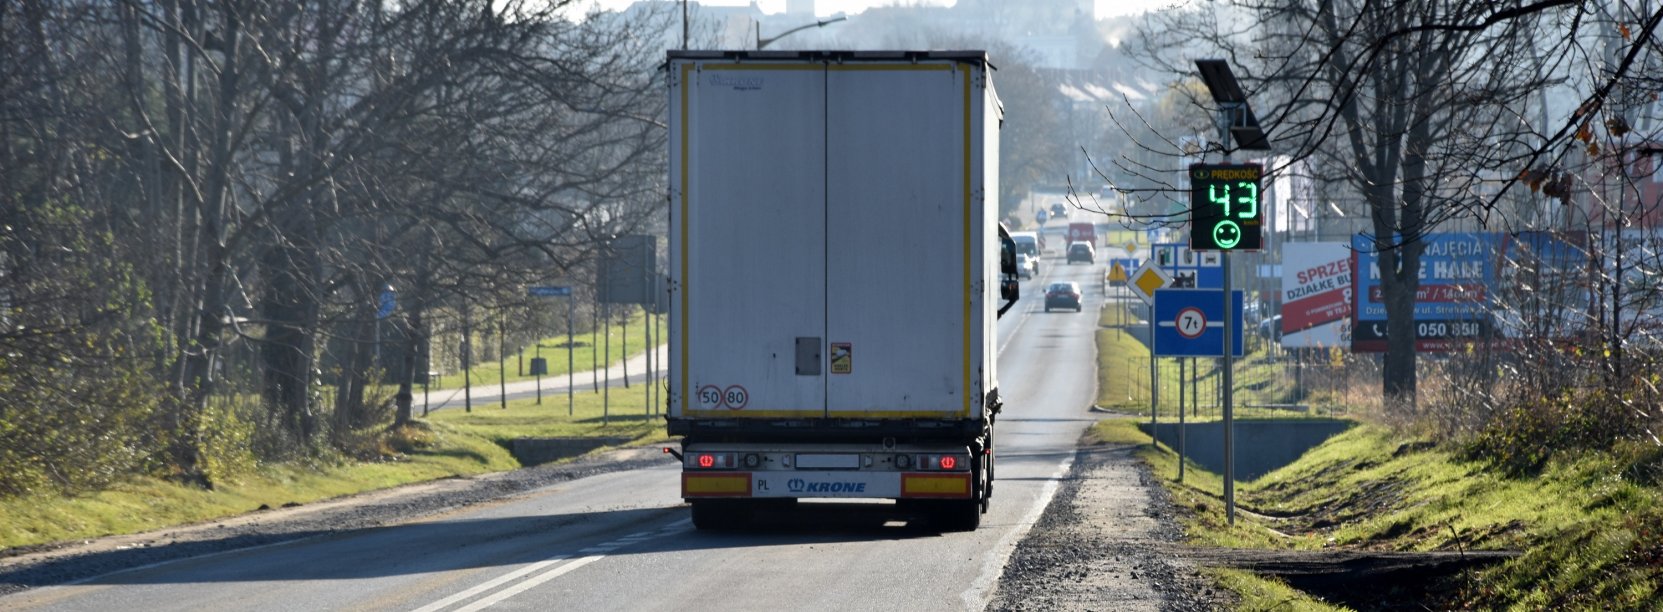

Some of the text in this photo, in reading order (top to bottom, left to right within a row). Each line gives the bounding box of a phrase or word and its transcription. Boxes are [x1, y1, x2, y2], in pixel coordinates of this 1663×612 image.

[1211, 168, 1258, 180] PRĘDKOŚĆ
[1209, 182, 1257, 218] 43
[1434, 261, 1483, 279] HALE
[1286, 278, 1335, 300] DZIAŁKĘ
[1419, 323, 1446, 336] 050
[702, 391, 719, 404] 50
[727, 391, 744, 404] 80
[757, 479, 866, 493] PL KRONE
